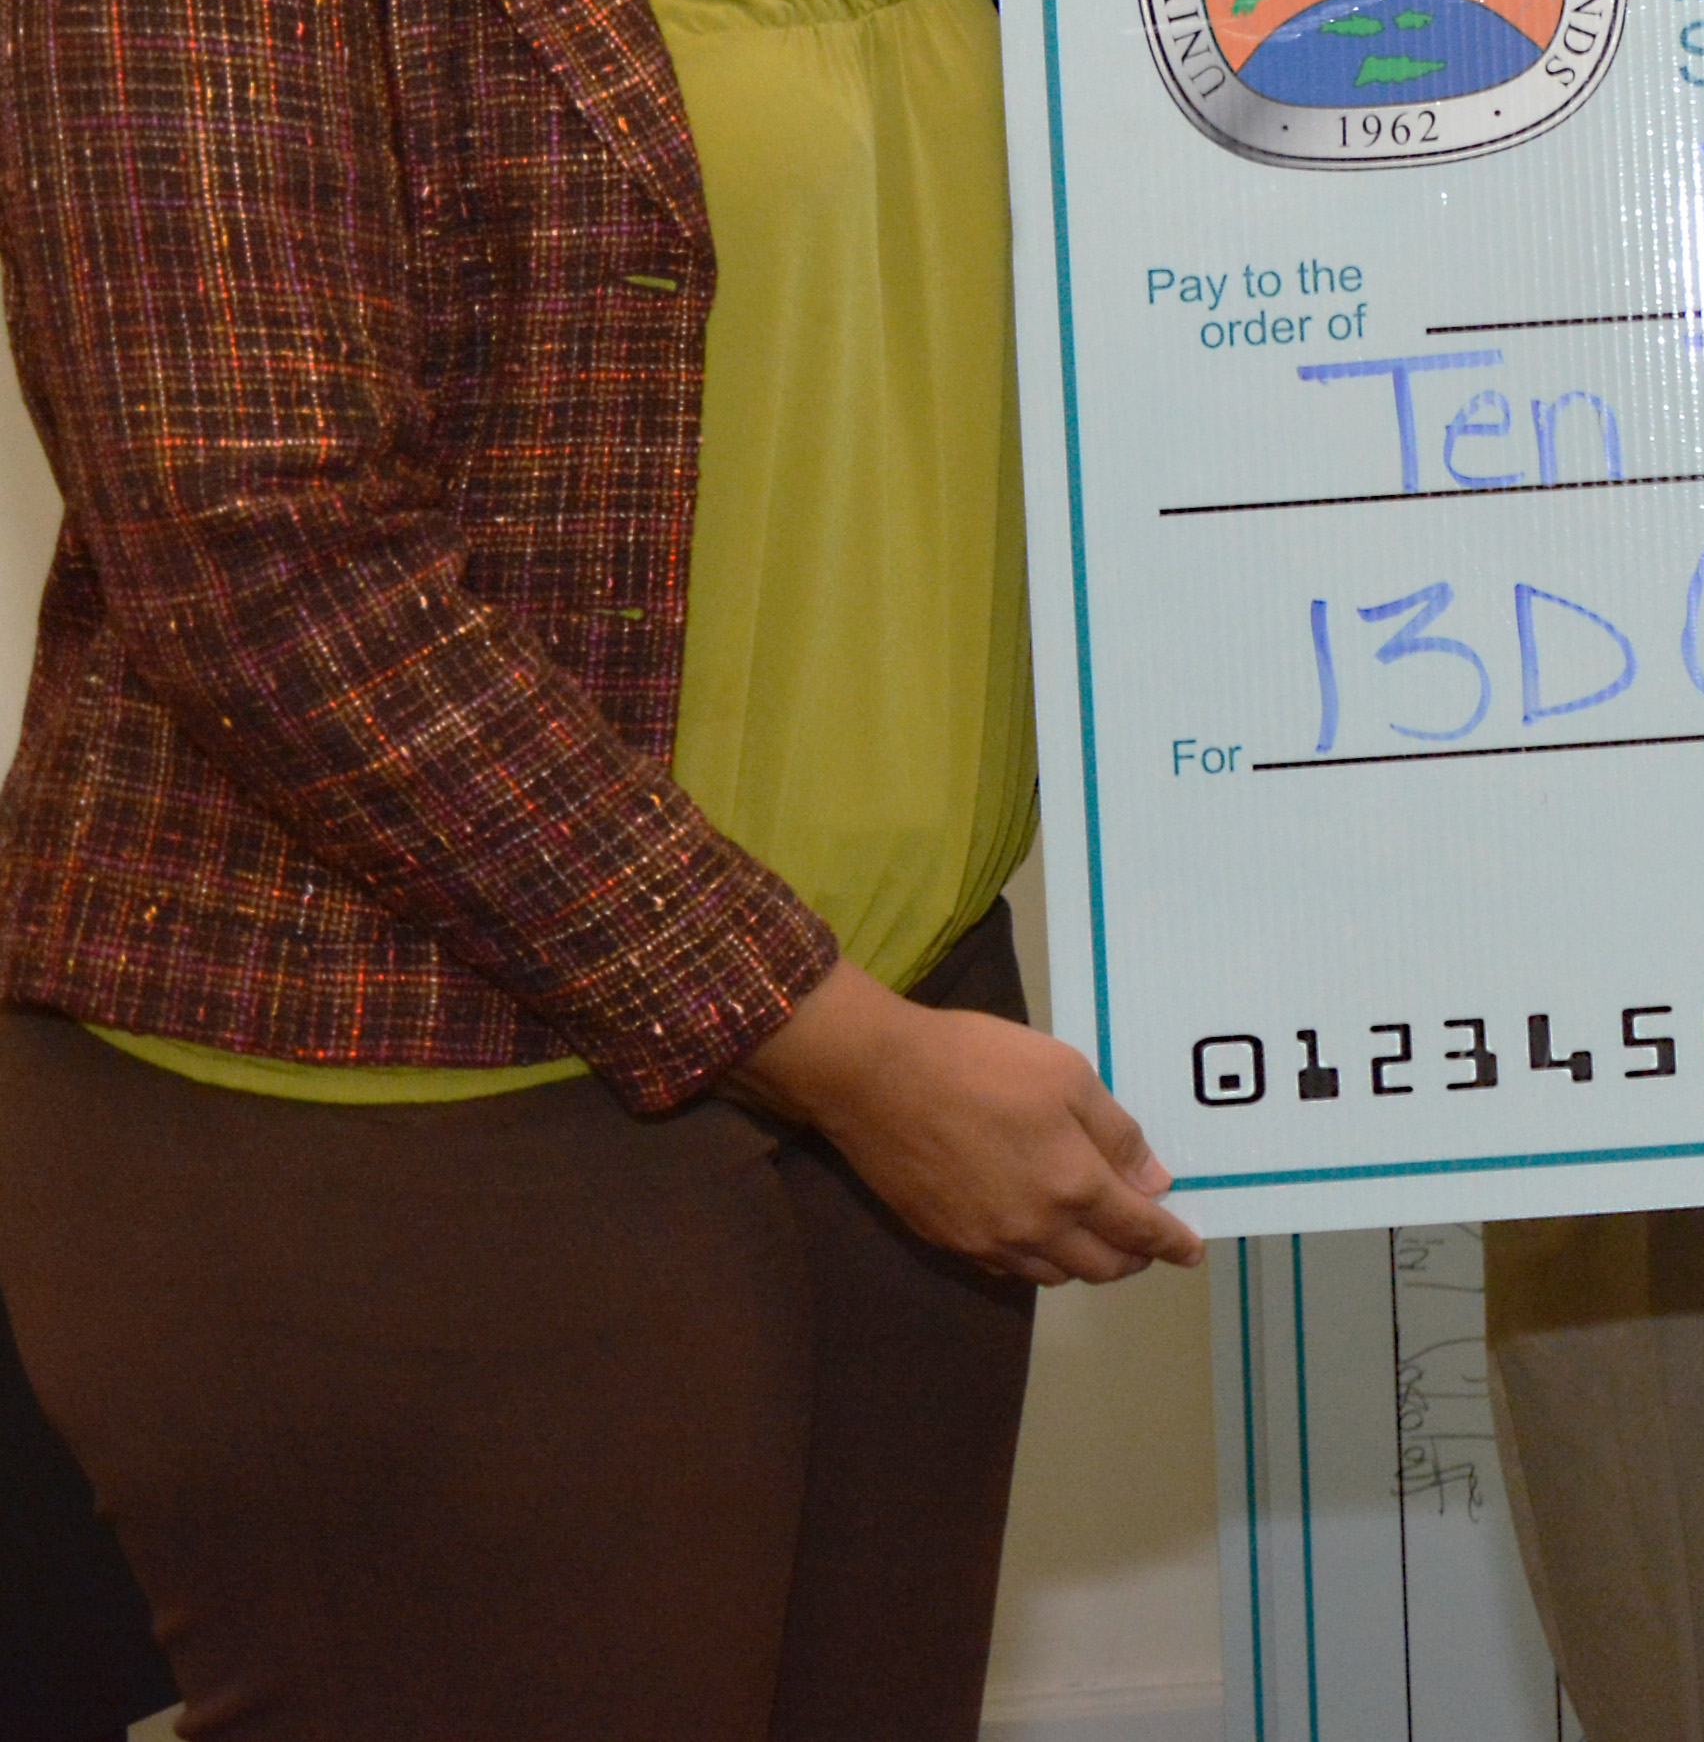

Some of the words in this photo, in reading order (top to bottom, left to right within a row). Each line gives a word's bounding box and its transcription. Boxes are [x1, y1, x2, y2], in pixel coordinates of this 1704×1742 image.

[1335, 110, 1443, 150] 1962
[1147, 267, 1229, 311] Pay
[1243, 263, 1283, 299] to
[1297, 258, 1364, 295] the
[1200, 310, 1313, 349] order
[1327, 302, 1368, 341] of
[1296, 347, 1624, 494] Ten
[1310, 581, 1638, 753] 13D
[1173, 739, 1243, 777] For
